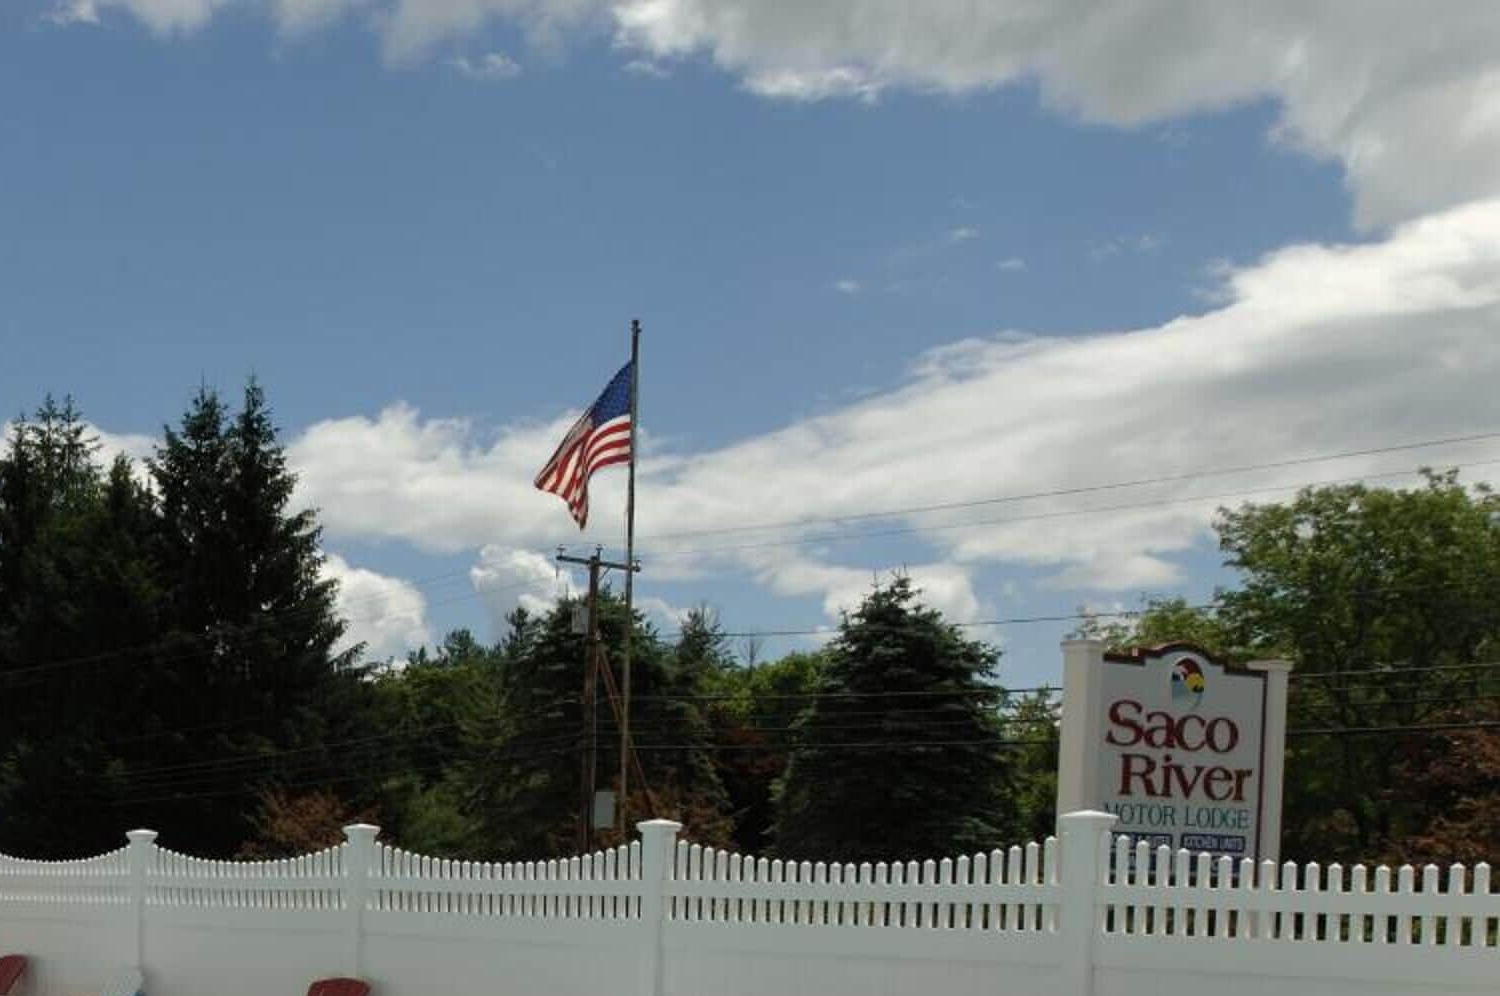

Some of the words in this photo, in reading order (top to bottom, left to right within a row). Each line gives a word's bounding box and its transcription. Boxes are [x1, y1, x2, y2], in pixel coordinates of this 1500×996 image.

[1106, 699, 1239, 753] Saco
[1119, 754, 1252, 801] River
[1185, 807, 1250, 829] LODGE
